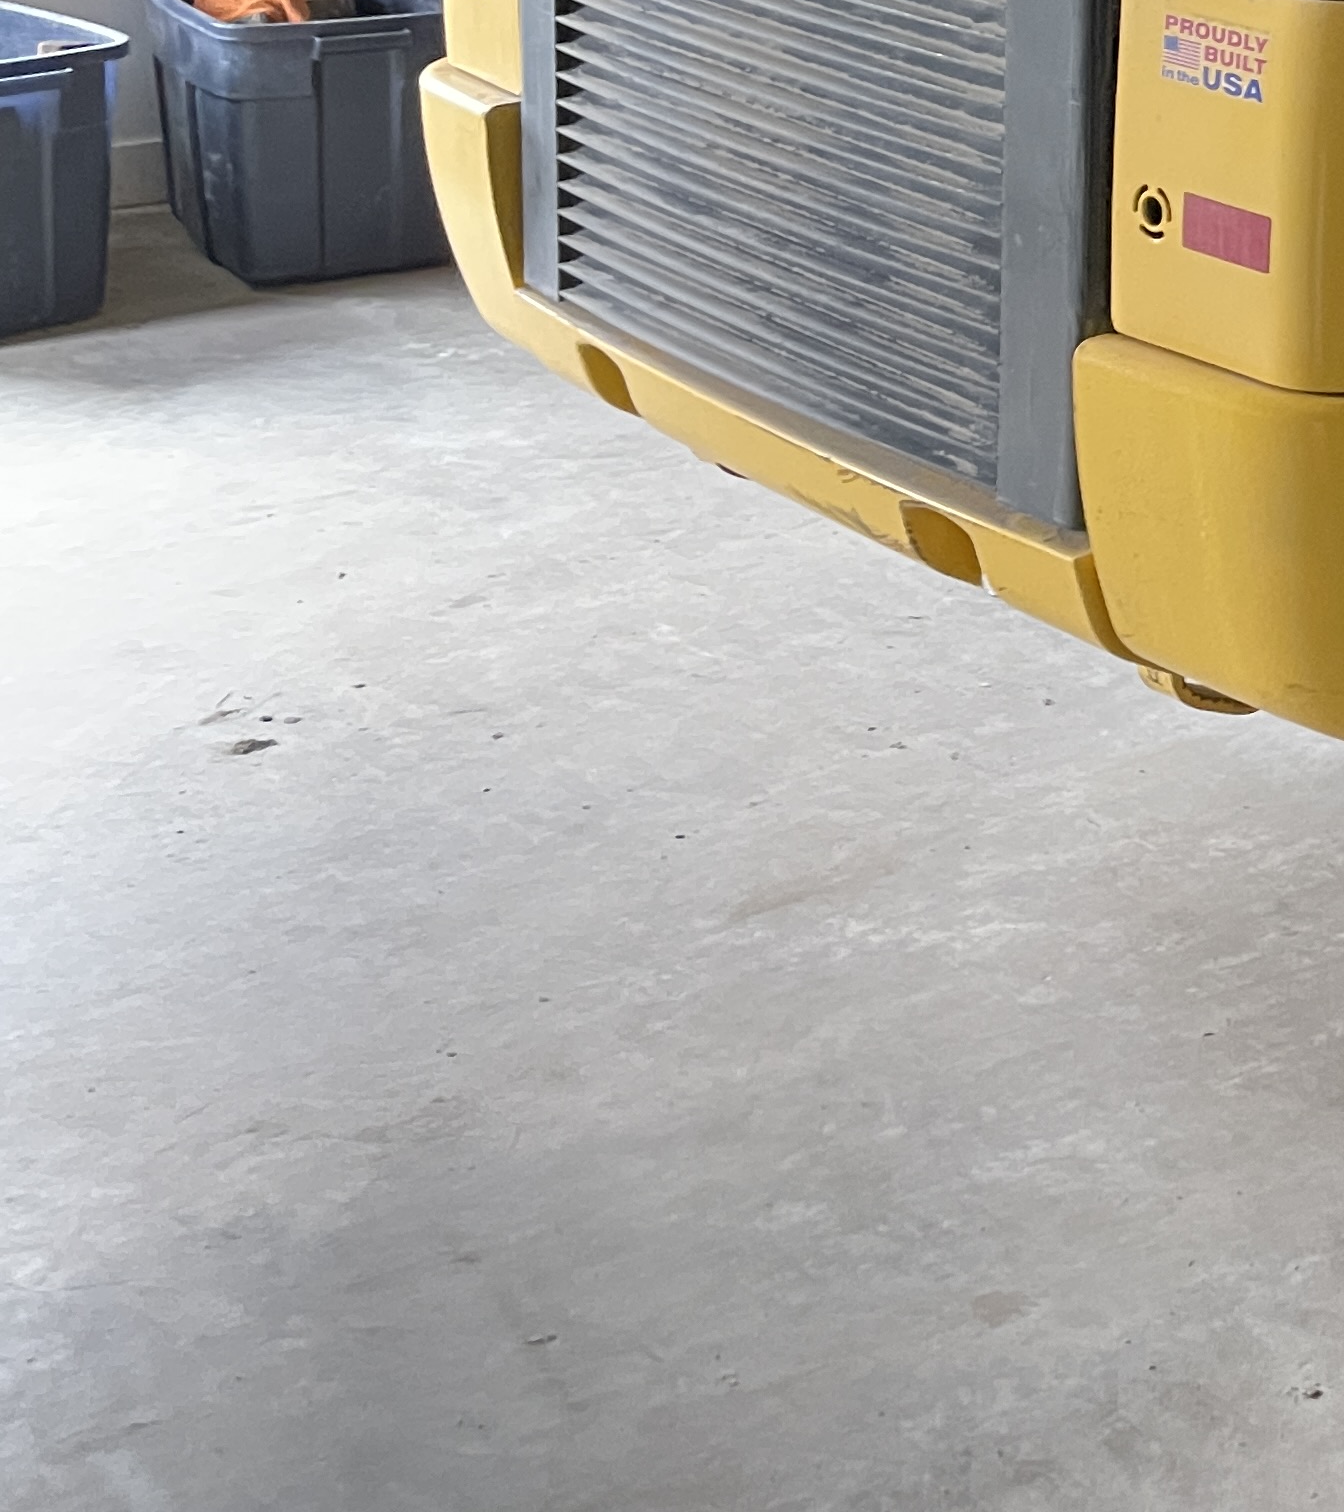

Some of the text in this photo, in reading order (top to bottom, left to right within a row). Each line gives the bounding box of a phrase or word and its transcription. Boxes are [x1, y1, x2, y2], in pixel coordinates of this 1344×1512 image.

[1164, 14, 1269, 54] PROUDLY
[1204, 45, 1268, 75] BUILT
[1161, 65, 1263, 104] in the USA
